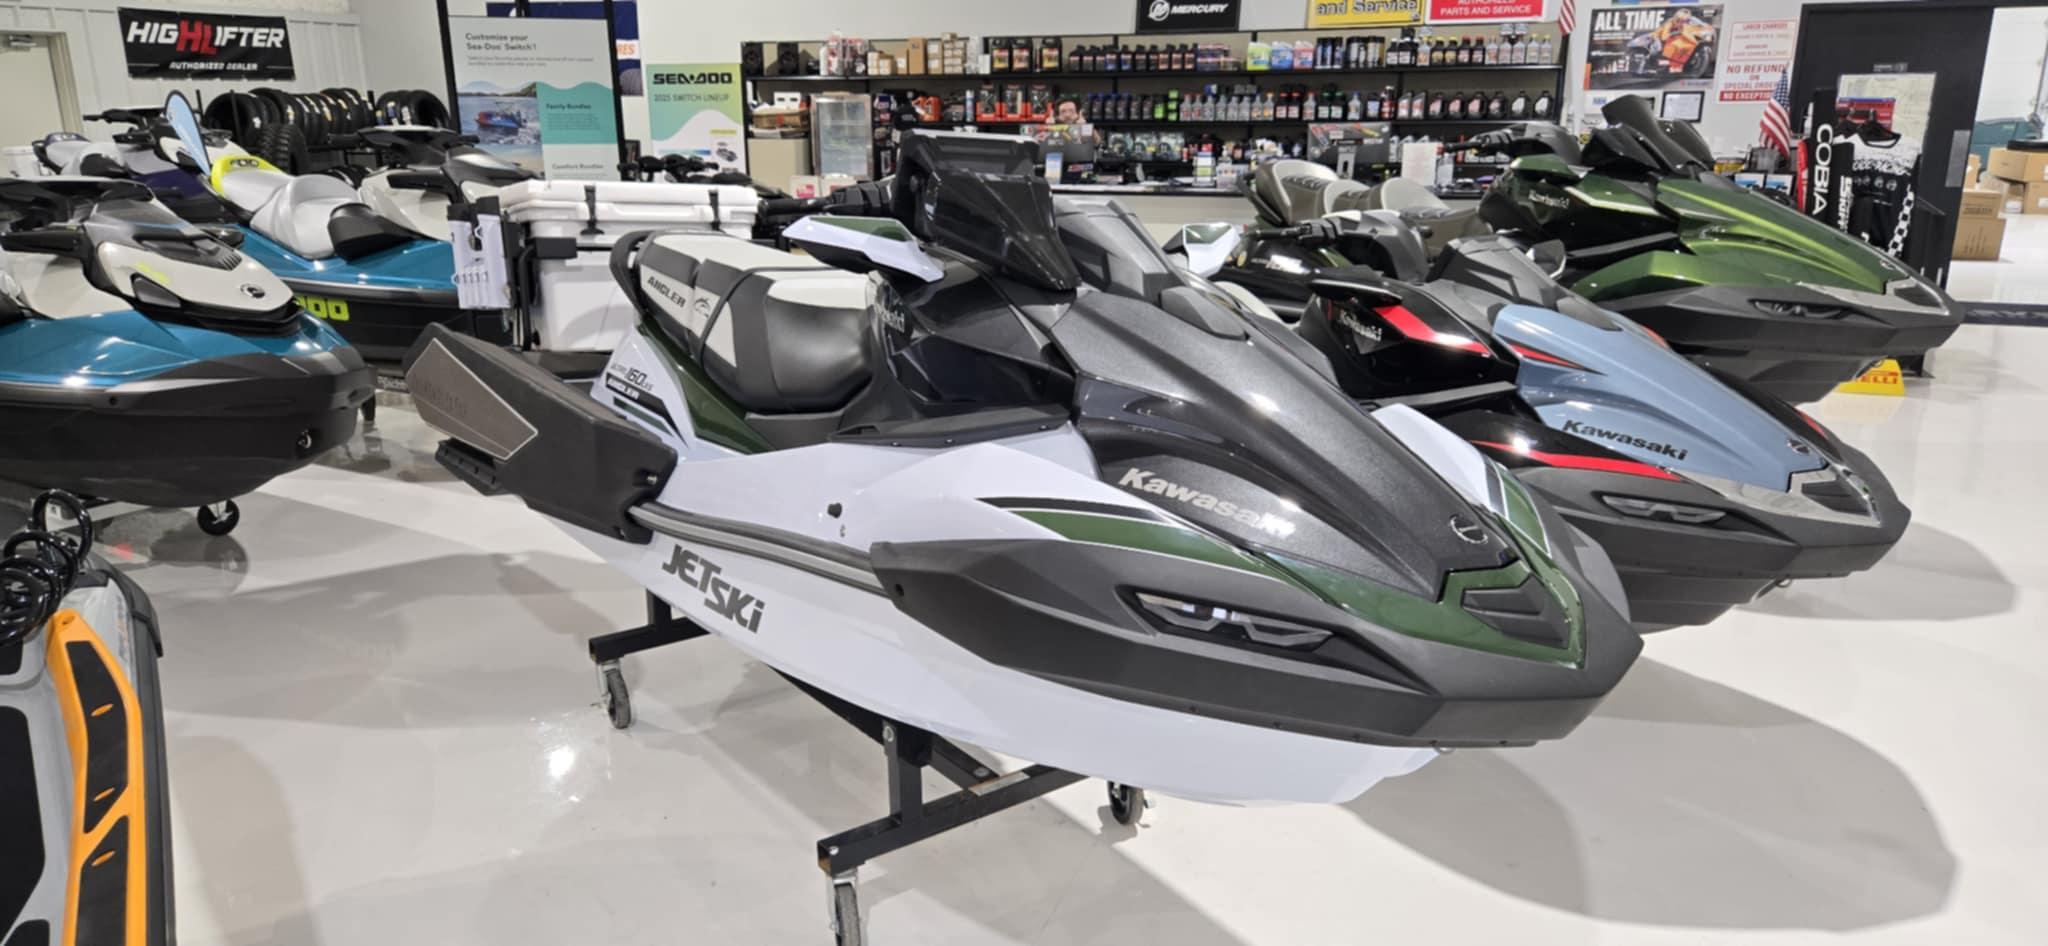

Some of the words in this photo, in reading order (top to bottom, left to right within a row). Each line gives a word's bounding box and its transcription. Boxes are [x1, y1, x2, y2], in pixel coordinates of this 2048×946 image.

[1171, 4, 1228, 14] MERCURY
[1317, 2, 1346, 14] and
[1353, 0, 1416, 13] Service
[1440, 7, 1469, 15] PARTS
[1471, 6, 1490, 14] AND
[1492, 5, 1531, 14] SERVICE
[1594, 12, 1622, 31] ALL
[465, 33, 508, 41] Customize
[169, 61, 225, 70] AUTHORIZED
[226, 62, 258, 70] DEALER
[1727, 65, 1741, 73] NO
[1812, 124, 1833, 215] COBIA
[647, 276, 687, 308] ANGLER
[1562, 420, 1689, 461] Kawasaki
[662, 543, 722, 594] JET
